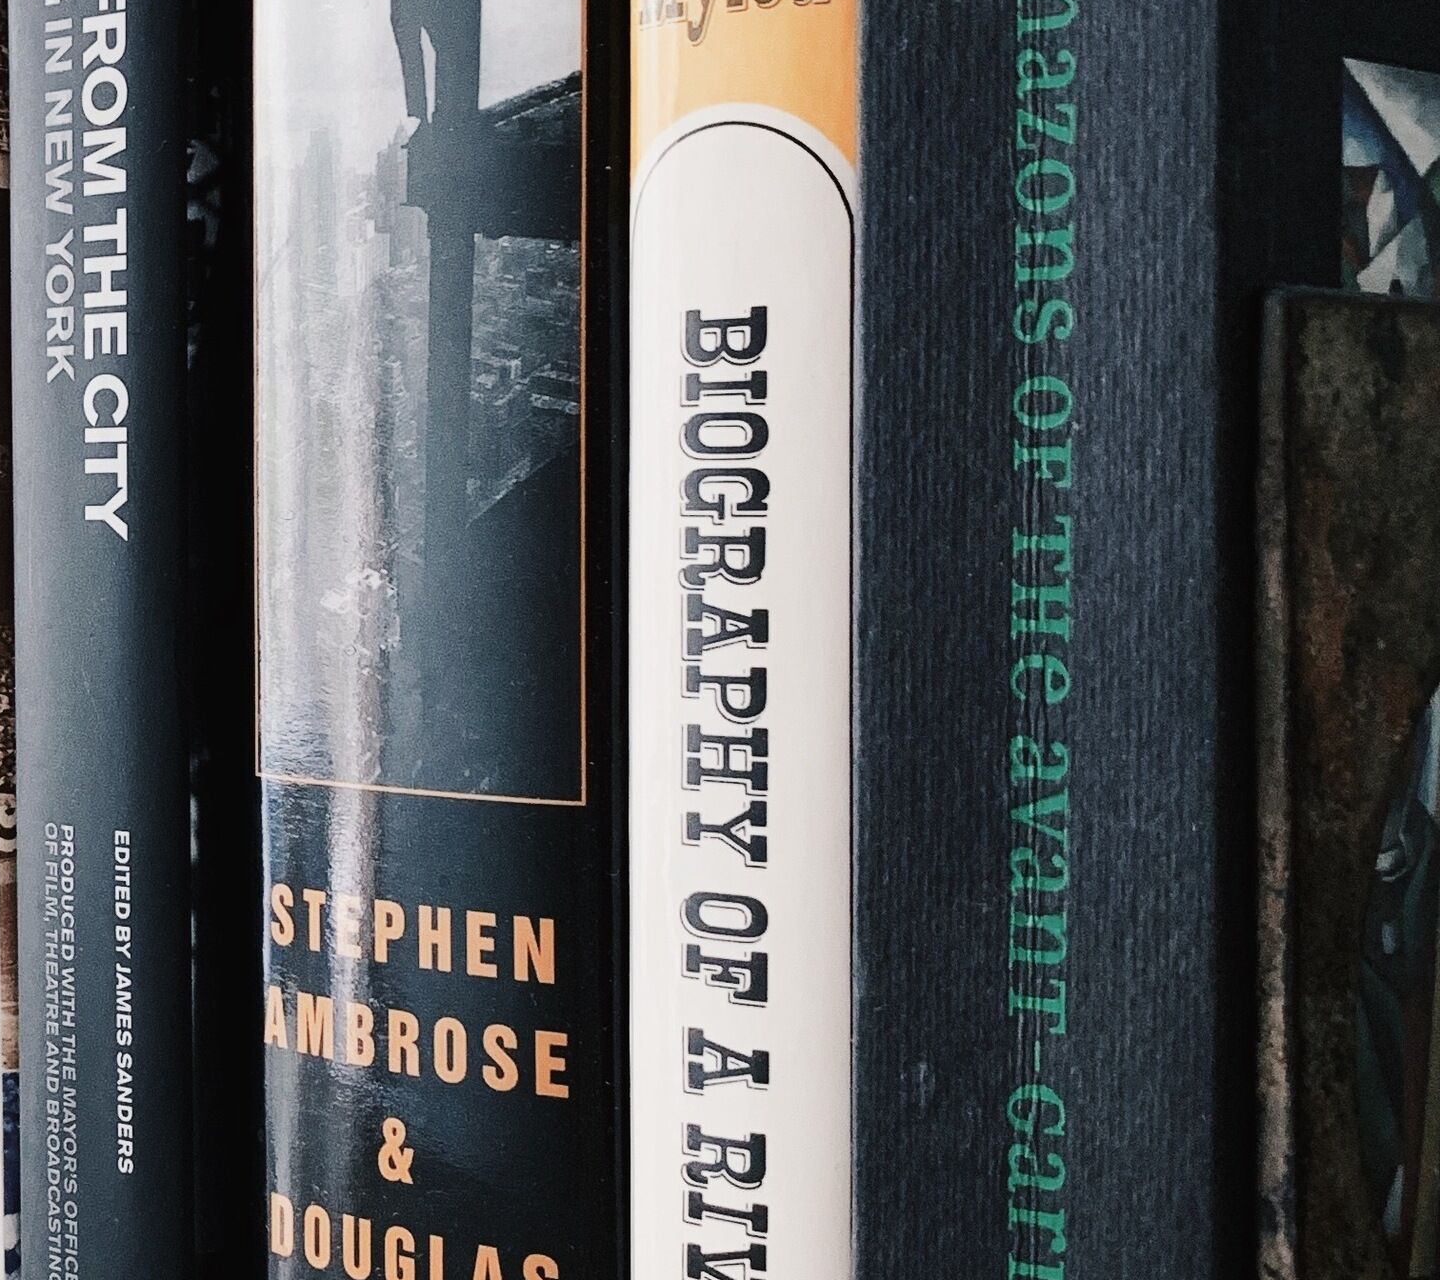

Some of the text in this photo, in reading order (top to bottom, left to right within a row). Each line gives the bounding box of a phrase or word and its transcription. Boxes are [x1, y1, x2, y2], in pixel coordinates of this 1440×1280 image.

[44, 18, 73, 74] IN
[44, 88, 74, 215] NEW
[45, 227, 76, 385] YORK
[83, 207, 128, 360] THE
[83, 373, 129, 542] CITY
[679, 305, 770, 869] BIOGRAPHY
[43, 861, 59, 921] FILM,
[44, 822, 59, 856] OF
[60, 824, 75, 960] PRODUCED
[45, 929, 60, 1035] THEATRE
[270, 883, 555, 984] STEPHEN
[679, 890, 769, 1008] OF
[62, 967, 76, 1027] WITH
[113, 829, 134, 1174] EDITED BY JAMES SANDERS
[263, 985, 570, 1099] AMBROSE
[46, 1040, 60, 1093] AND
[62, 1034, 76, 1081] THE
[682, 1026, 770, 1095] A
[62, 1086, 78, 1193] MAYOR'S
[377, 1117, 415, 1185] &
